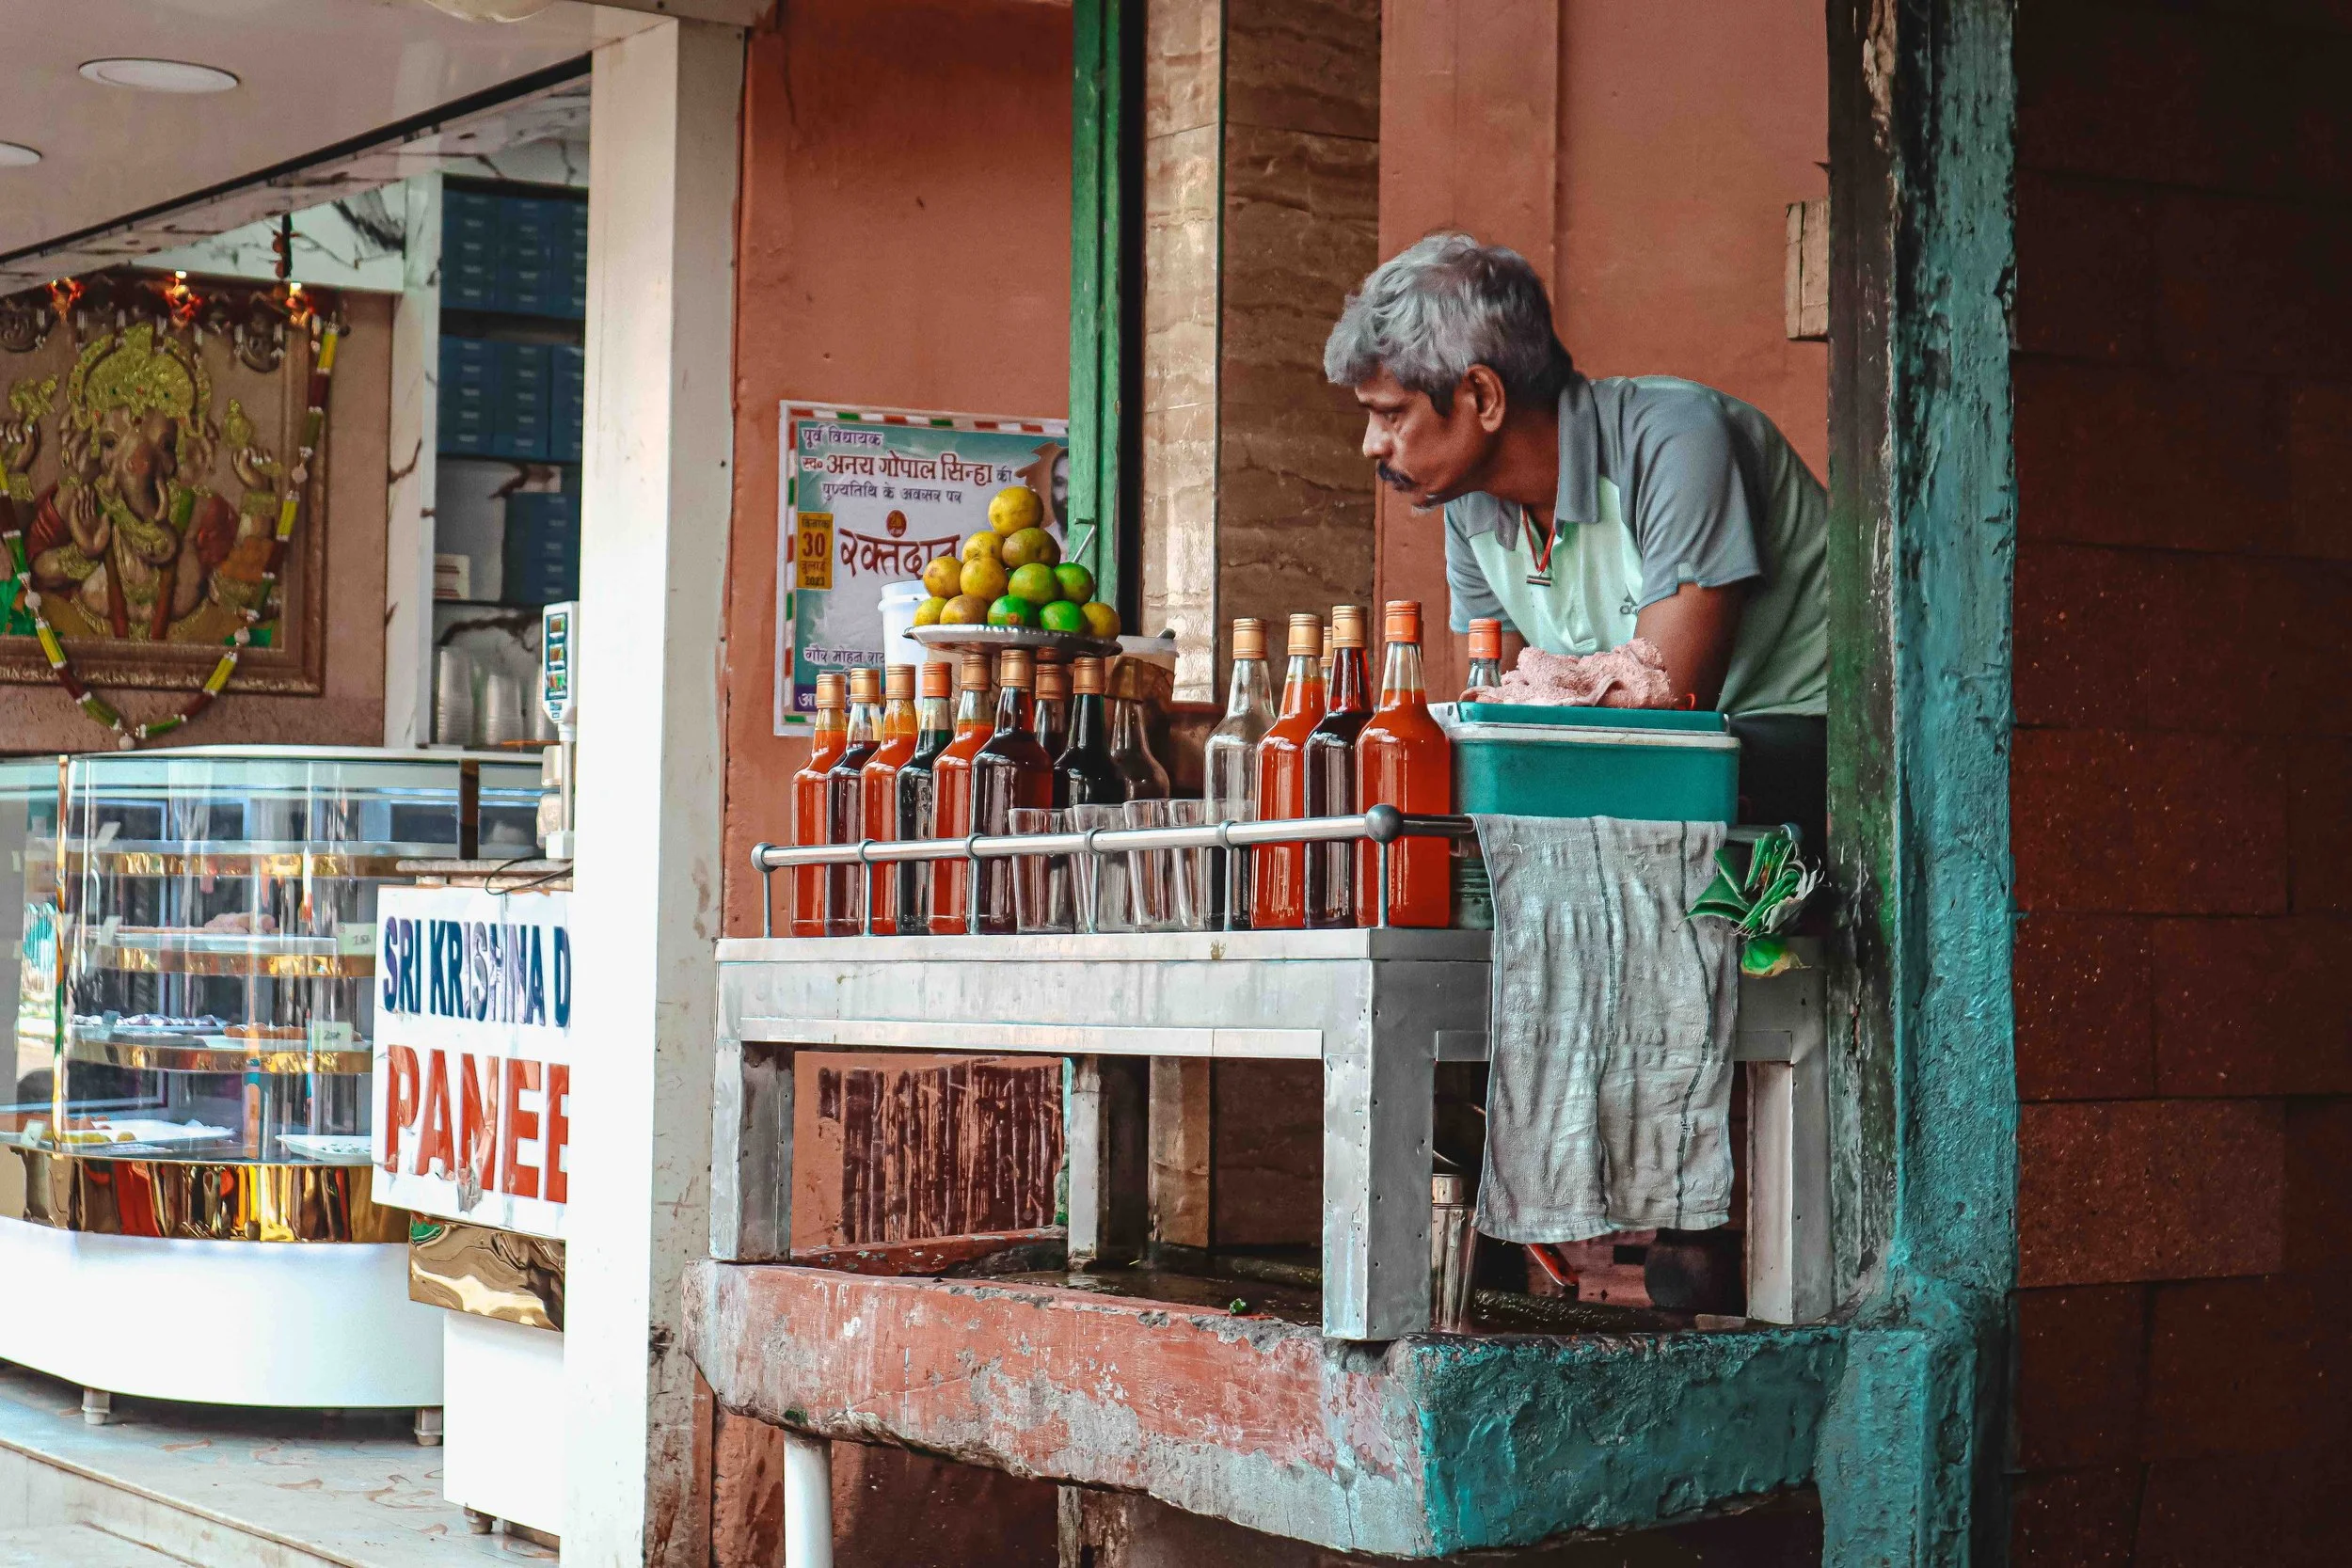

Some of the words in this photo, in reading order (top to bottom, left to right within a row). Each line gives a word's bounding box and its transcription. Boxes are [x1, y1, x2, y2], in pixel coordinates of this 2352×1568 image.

[803, 425, 822, 449] पूर्व
[829, 425, 882, 446] विधायक
[879, 450, 935, 479] गोपाल
[941, 452, 993, 485] सिन्हा
[996, 465, 1012, 482] की
[822, 480, 878, 500] पुण्यतिथि
[883, 481, 896, 499] के
[901, 487, 941, 500] अवसर
[946, 489, 961, 503] पर
[802, 531, 826, 558] 30
[833, 646, 864, 665] मोहन
[383, 915, 421, 1014] SRI
[429, 919, 546, 1026] KRISHNA
[384, 1043, 570, 1204] PANEE
